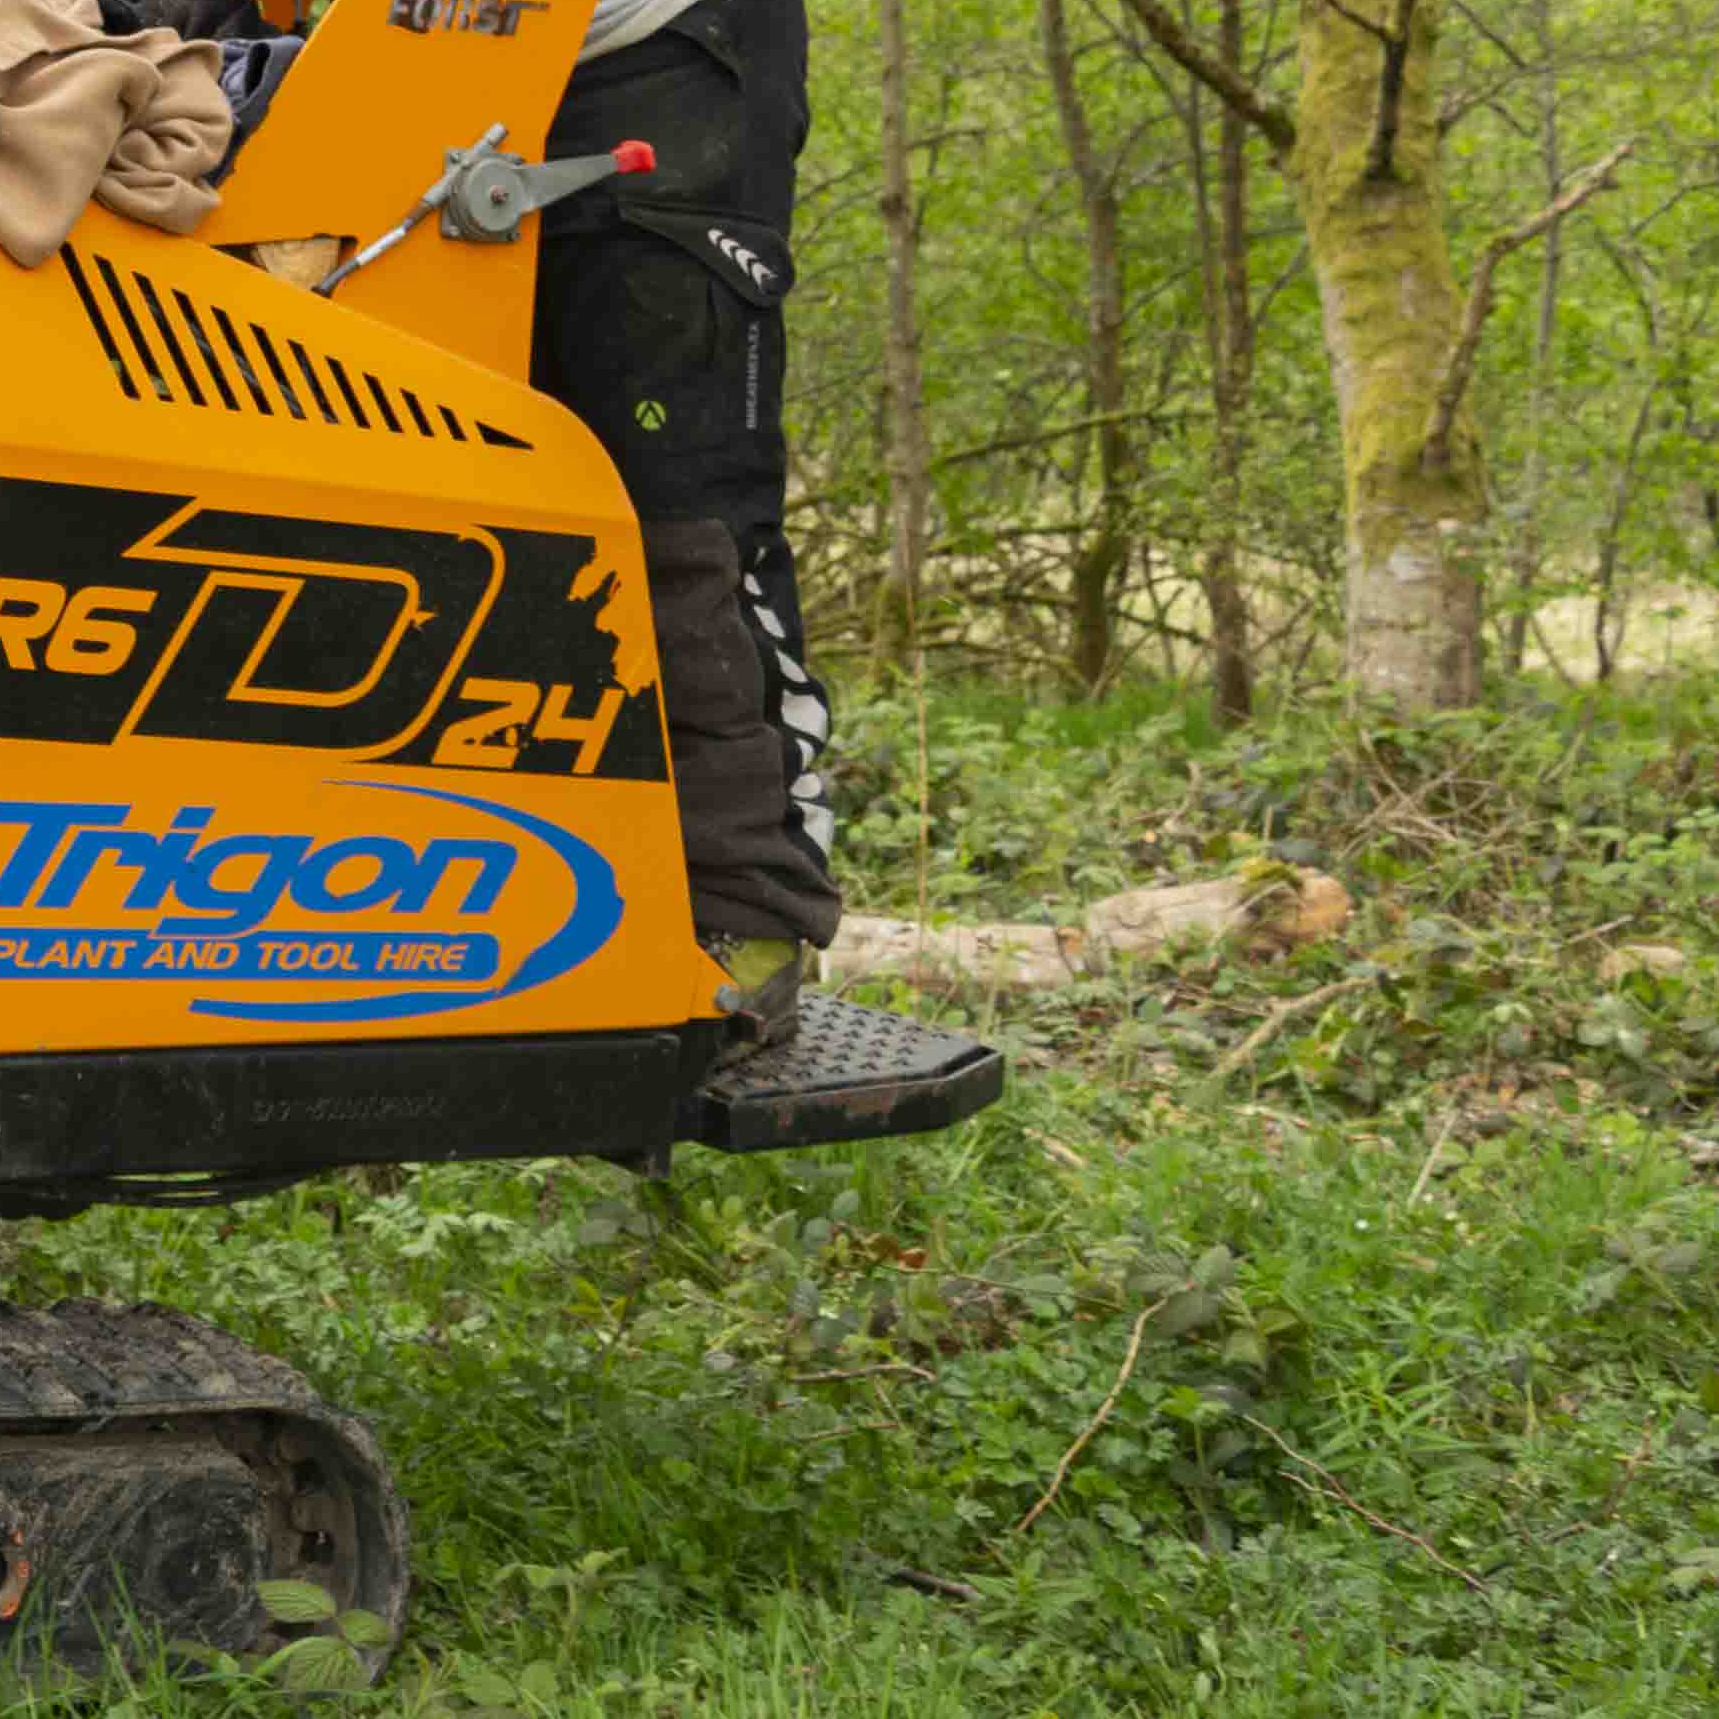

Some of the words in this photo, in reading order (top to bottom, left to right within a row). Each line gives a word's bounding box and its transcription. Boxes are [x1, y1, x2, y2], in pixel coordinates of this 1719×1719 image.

[432, 676, 626, 774] 24
[144, 938, 241, 971] AND
[256, 940, 360, 971] TOOL
[375, 942, 472, 972] HIRE
